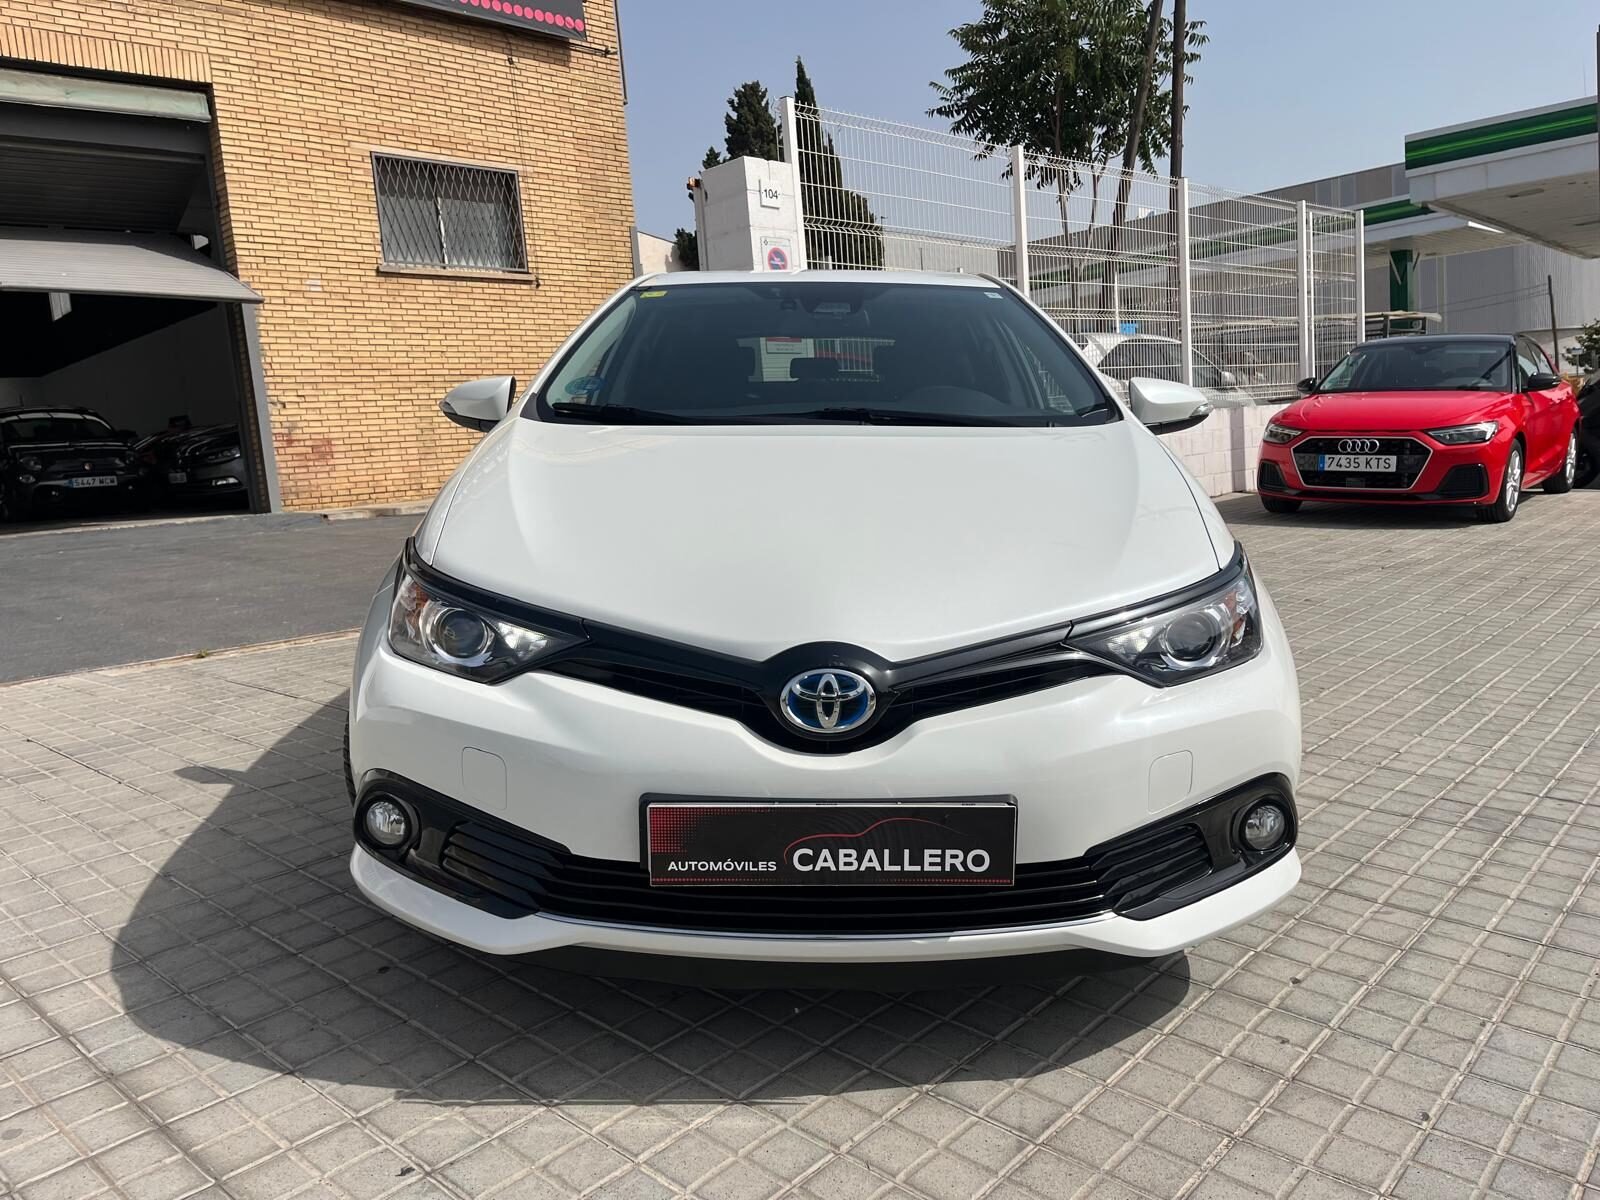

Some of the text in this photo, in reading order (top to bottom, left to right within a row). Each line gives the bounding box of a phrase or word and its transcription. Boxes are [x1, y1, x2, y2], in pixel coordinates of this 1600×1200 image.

[1327, 456, 1391, 469] 7435 KTS
[667, 848, 991, 872] AUTOMÓVILES CABALLERO
